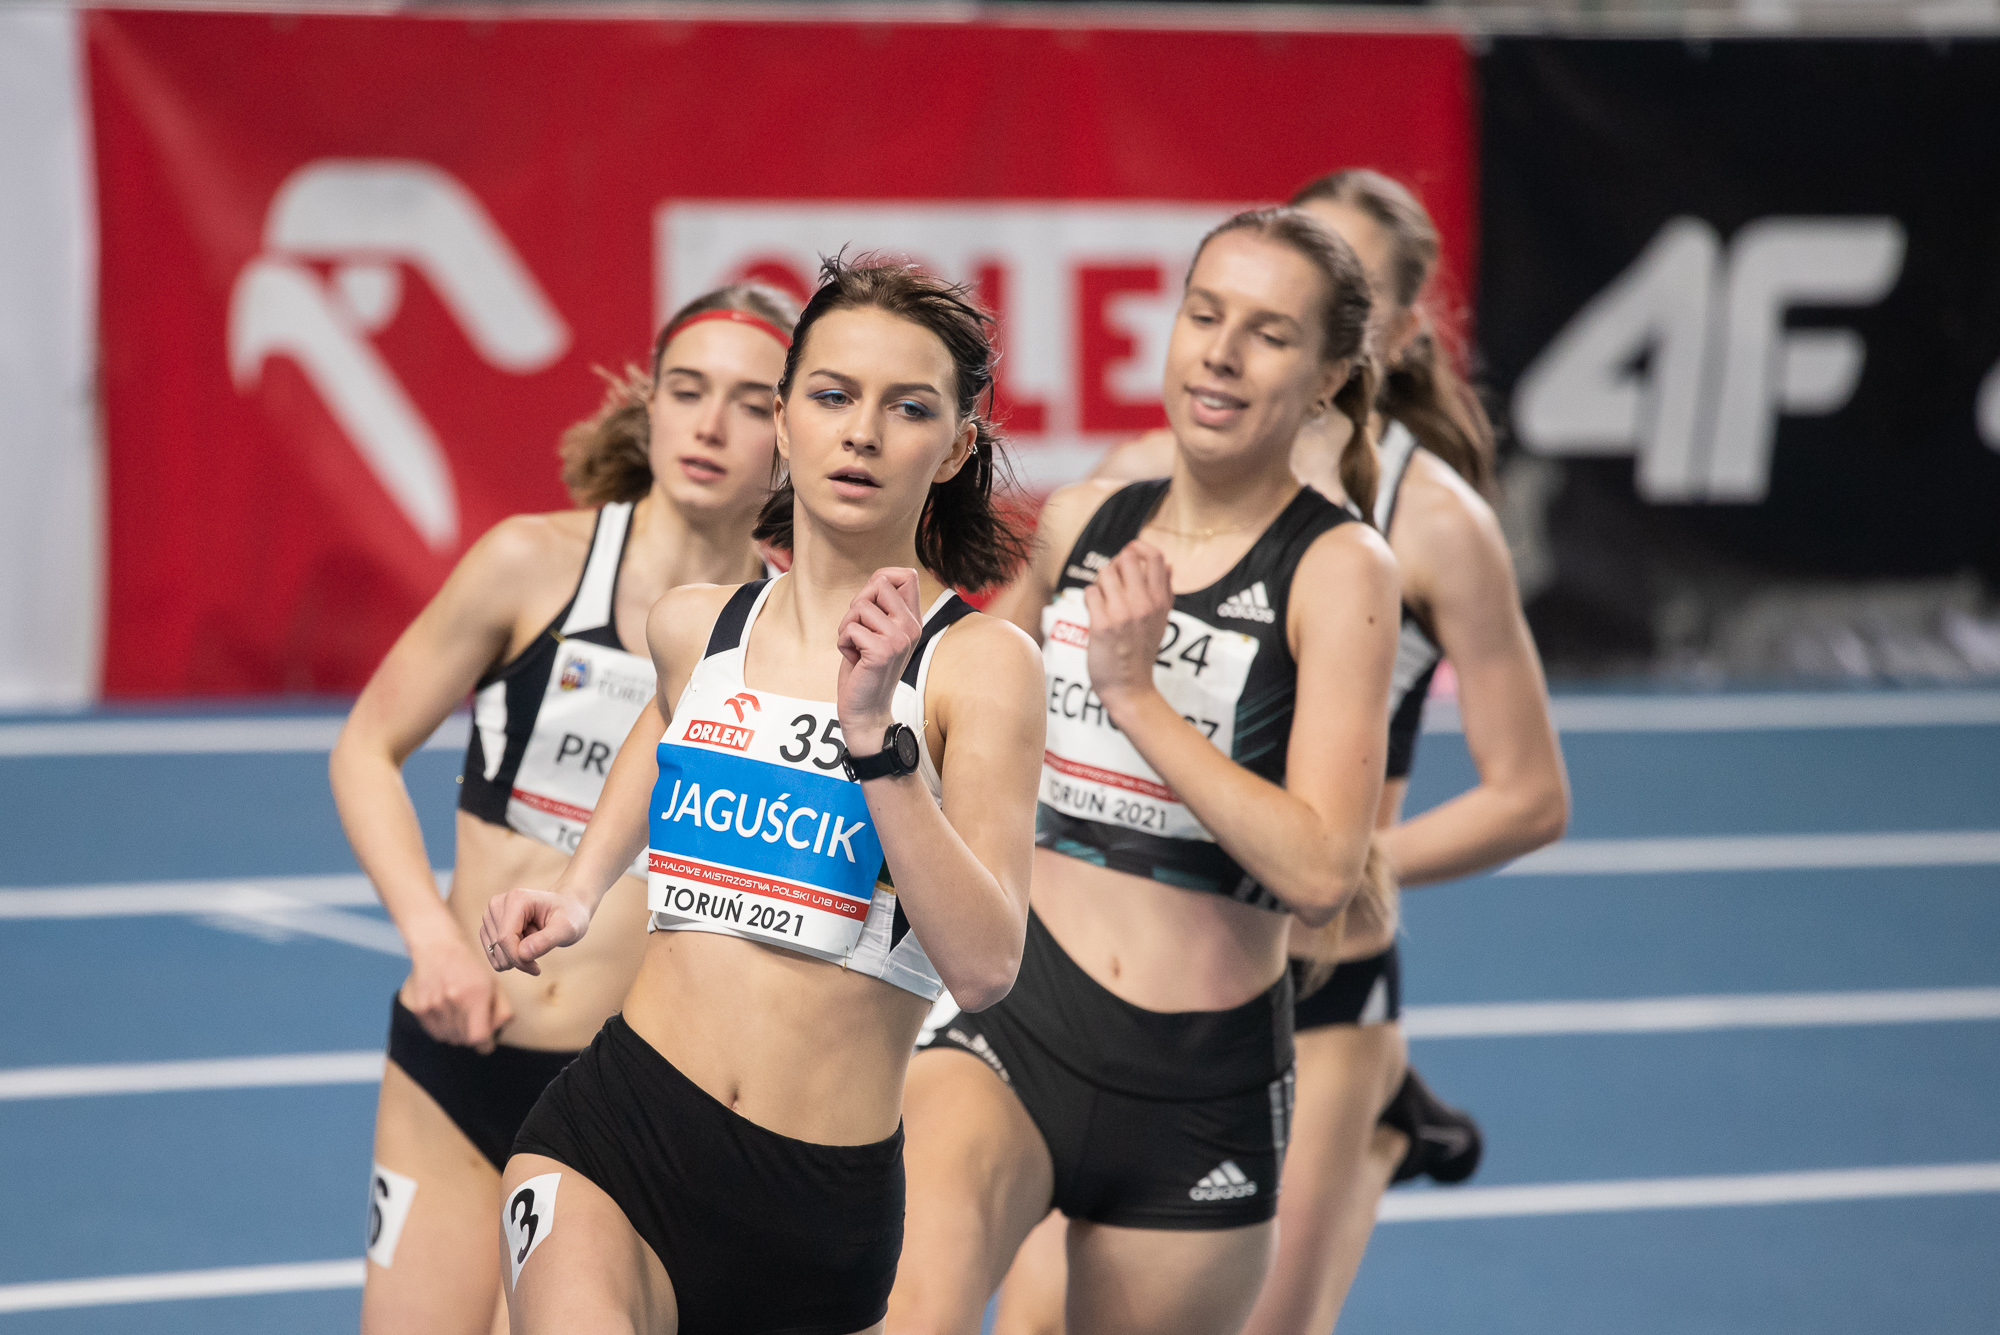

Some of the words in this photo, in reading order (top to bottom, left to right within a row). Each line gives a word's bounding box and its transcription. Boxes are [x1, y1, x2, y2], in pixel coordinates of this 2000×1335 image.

[1514, 216, 1906, 502] 4F
[556, 733, 611, 775] PR
[688, 722, 750, 748] ORLEN
[661, 779, 866, 863] JAGUŚCIK
[1114, 800, 1166, 830] 2021
[661, 861, 701, 876] HALOWE
[702, 870, 770, 891] MISTRZOSTWA
[772, 885, 810, 901] POLSKI
[812, 895, 833, 907] U18
[835, 901, 857, 913] U20
[664, 885, 743, 923] TORUŃ
[747, 904, 804, 937] 2021
[510, 1188, 539, 1264] 3
